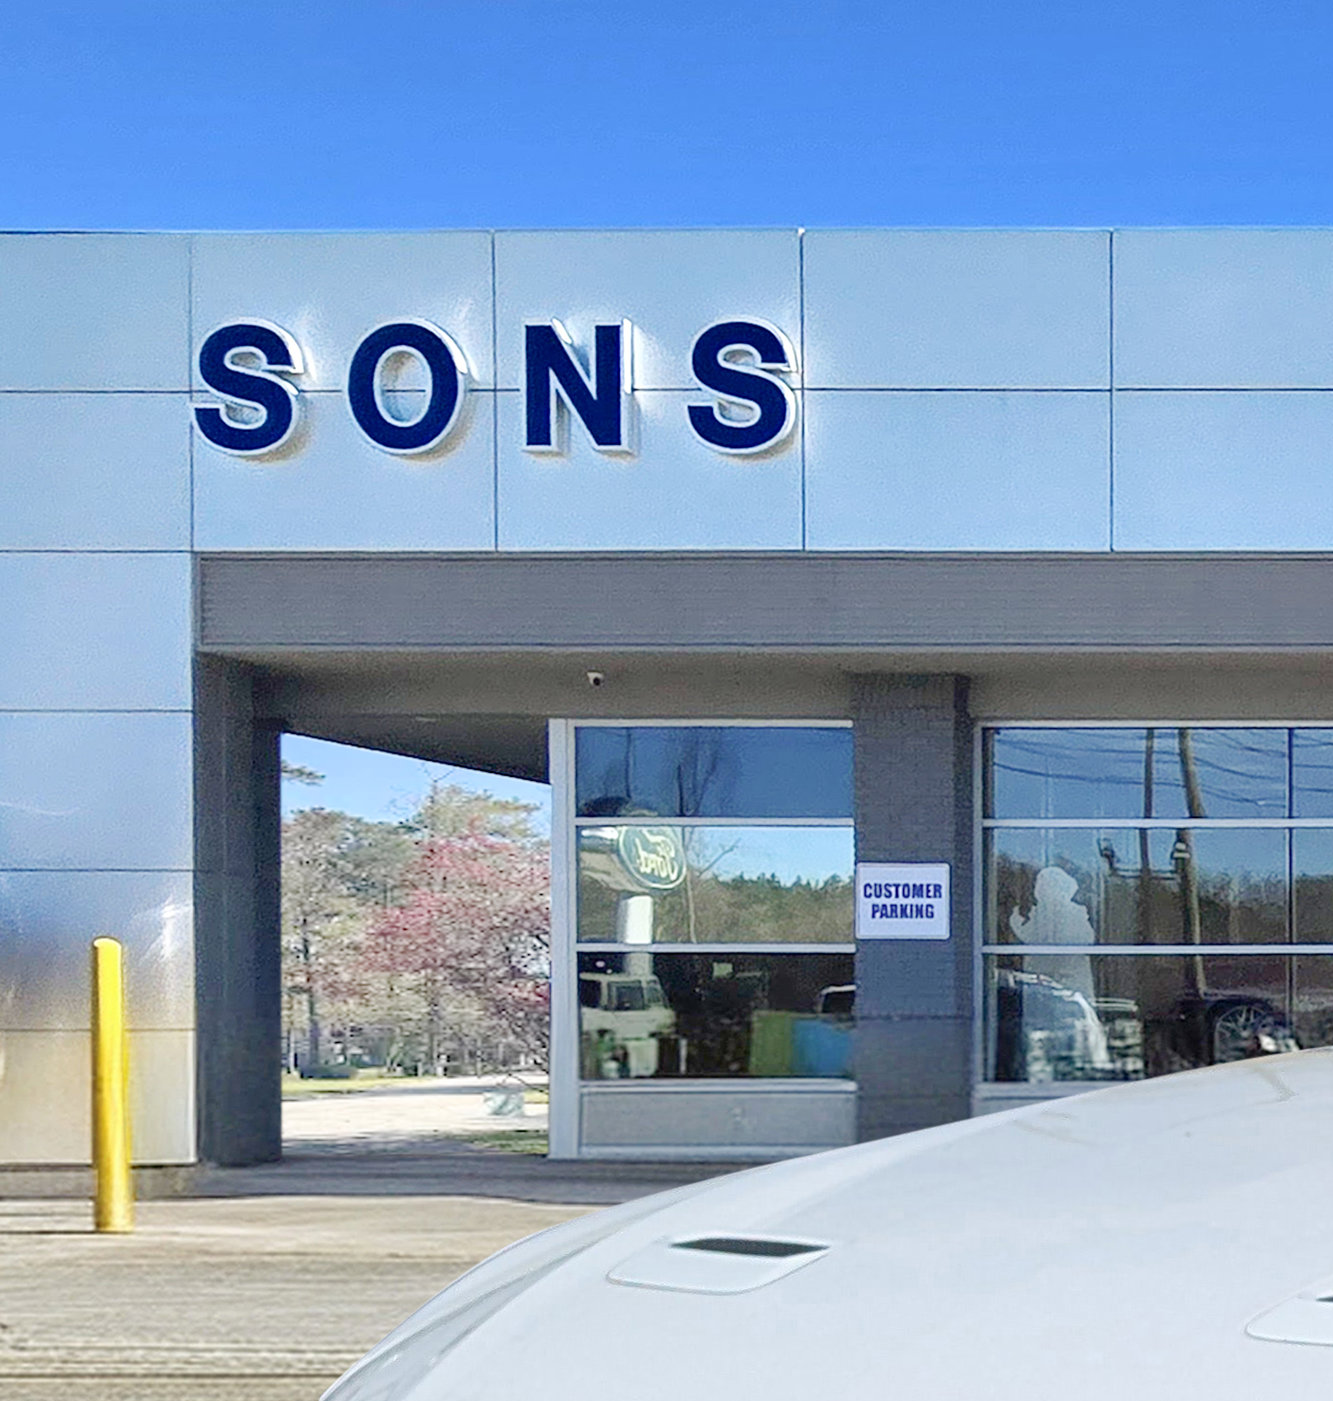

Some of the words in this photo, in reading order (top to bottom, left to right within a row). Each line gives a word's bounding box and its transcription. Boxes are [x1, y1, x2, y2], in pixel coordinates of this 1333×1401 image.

[193, 320, 796, 453] SONS
[863, 882, 943, 899] CUSTOMER
[871, 903, 935, 919] PARKING
